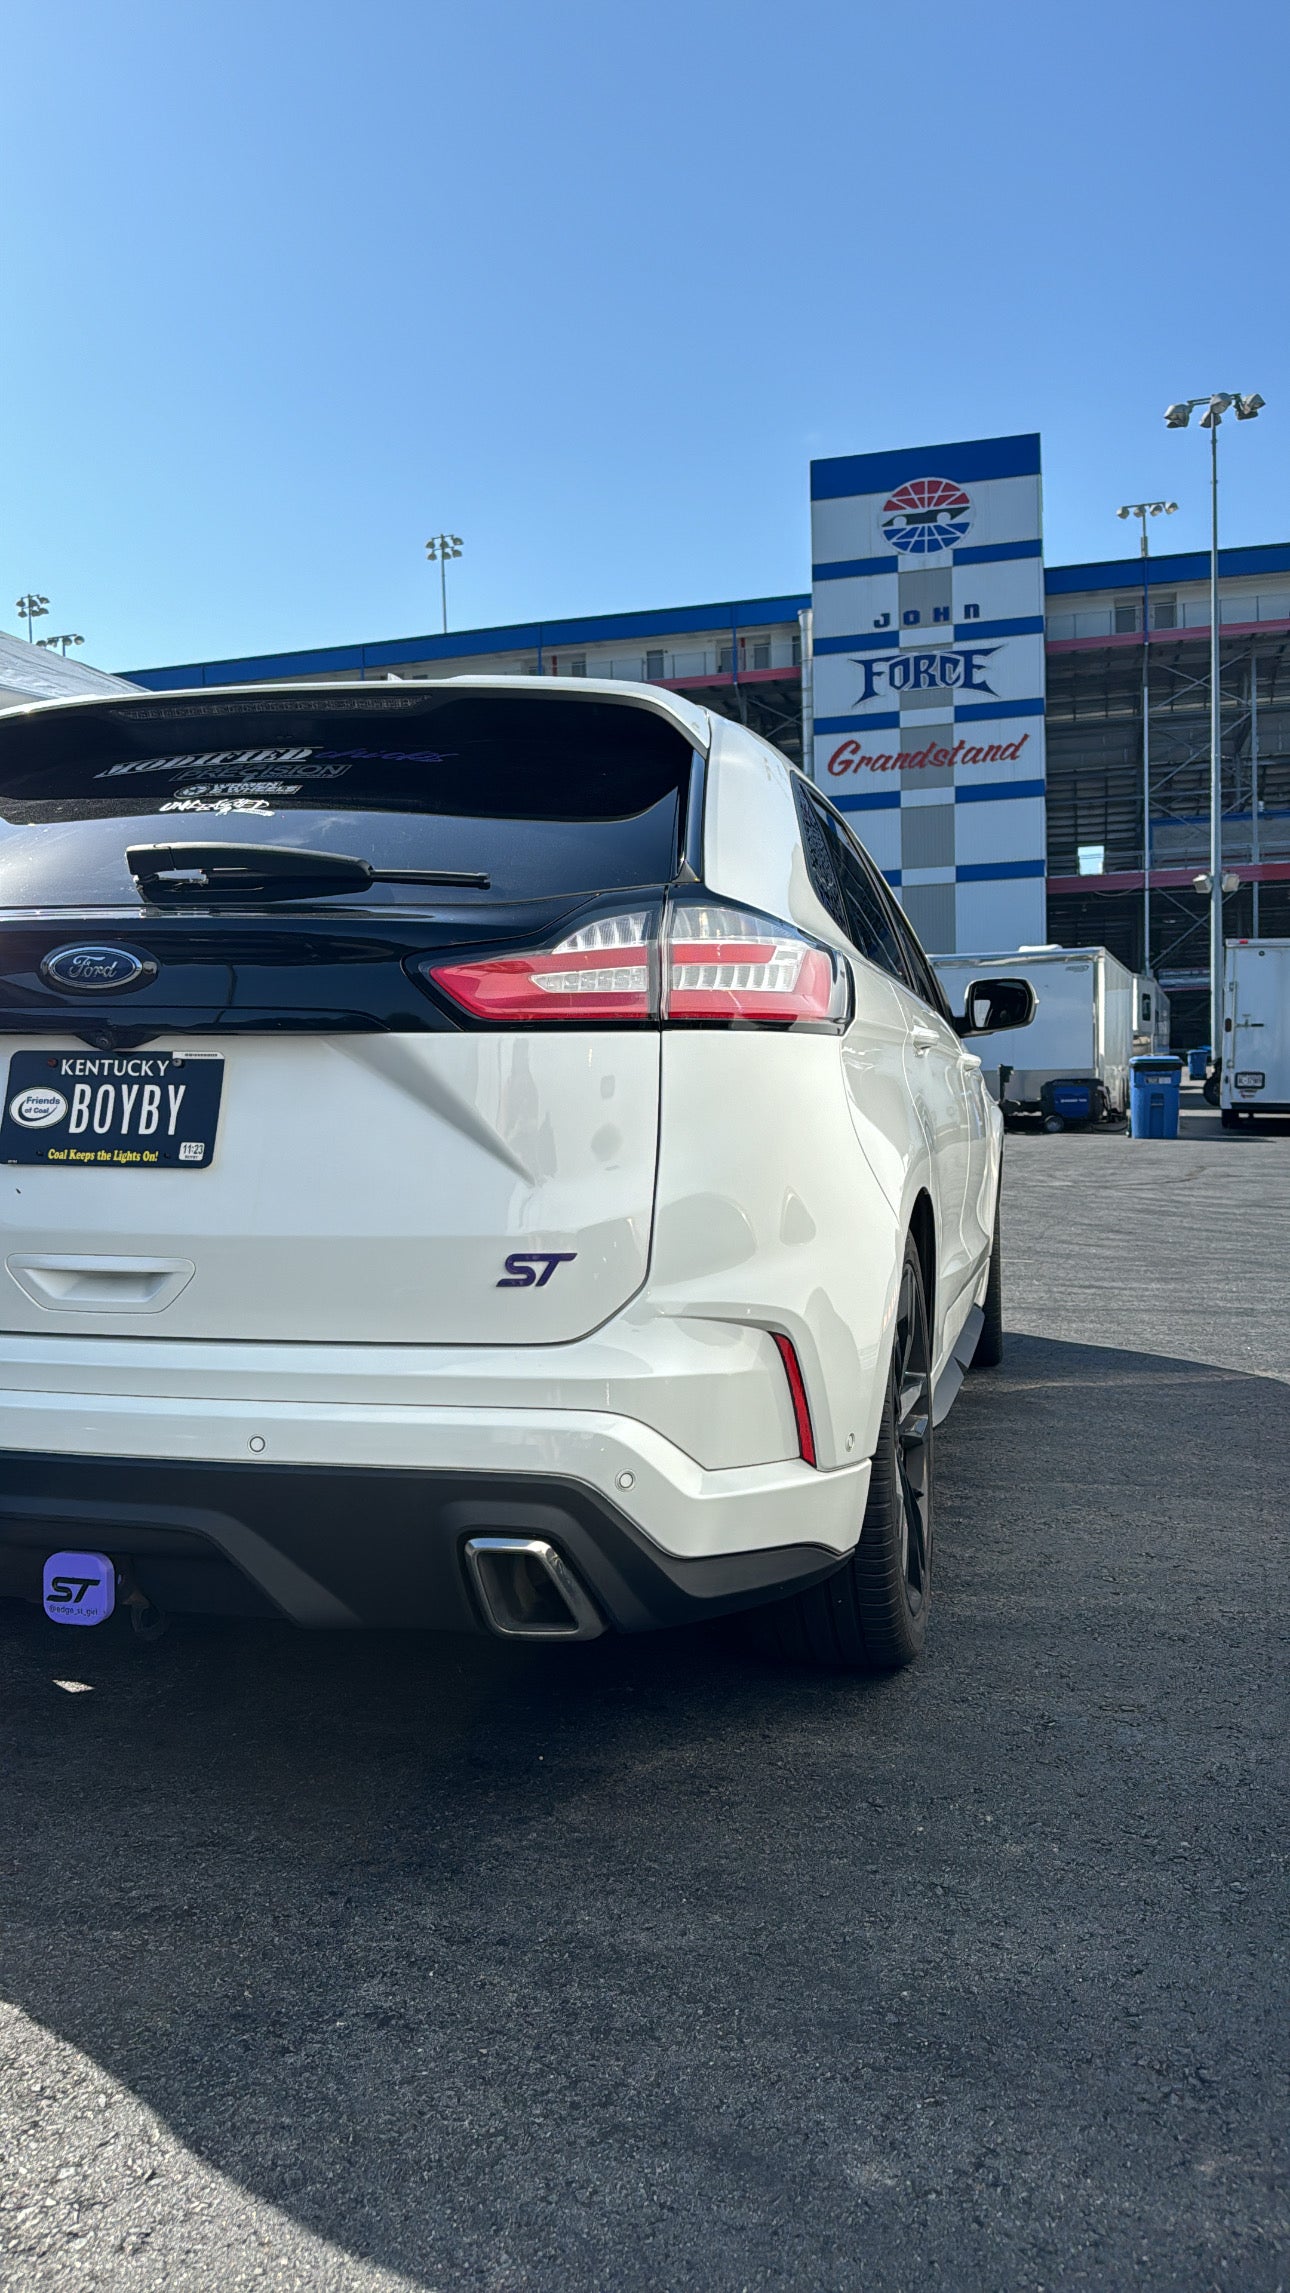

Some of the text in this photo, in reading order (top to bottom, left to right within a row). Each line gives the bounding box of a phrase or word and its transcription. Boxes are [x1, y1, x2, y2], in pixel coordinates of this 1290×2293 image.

[849, 645, 1007, 707] FORCE
[98, 747, 318, 777] MODIFIED
[827, 734, 1030, 777] Grandstand
[68, 955, 118, 978] Ford
[60, 1059, 170, 1077] KENTUCKY
[26, 1096, 61, 1105] Friends
[68, 1083, 187, 1136] BOYBY
[47, 1148, 159, 1163] Coal Keeps the Lights On!
[495, 1252, 578, 1288] ST
[46, 1576, 101, 1604] ST
